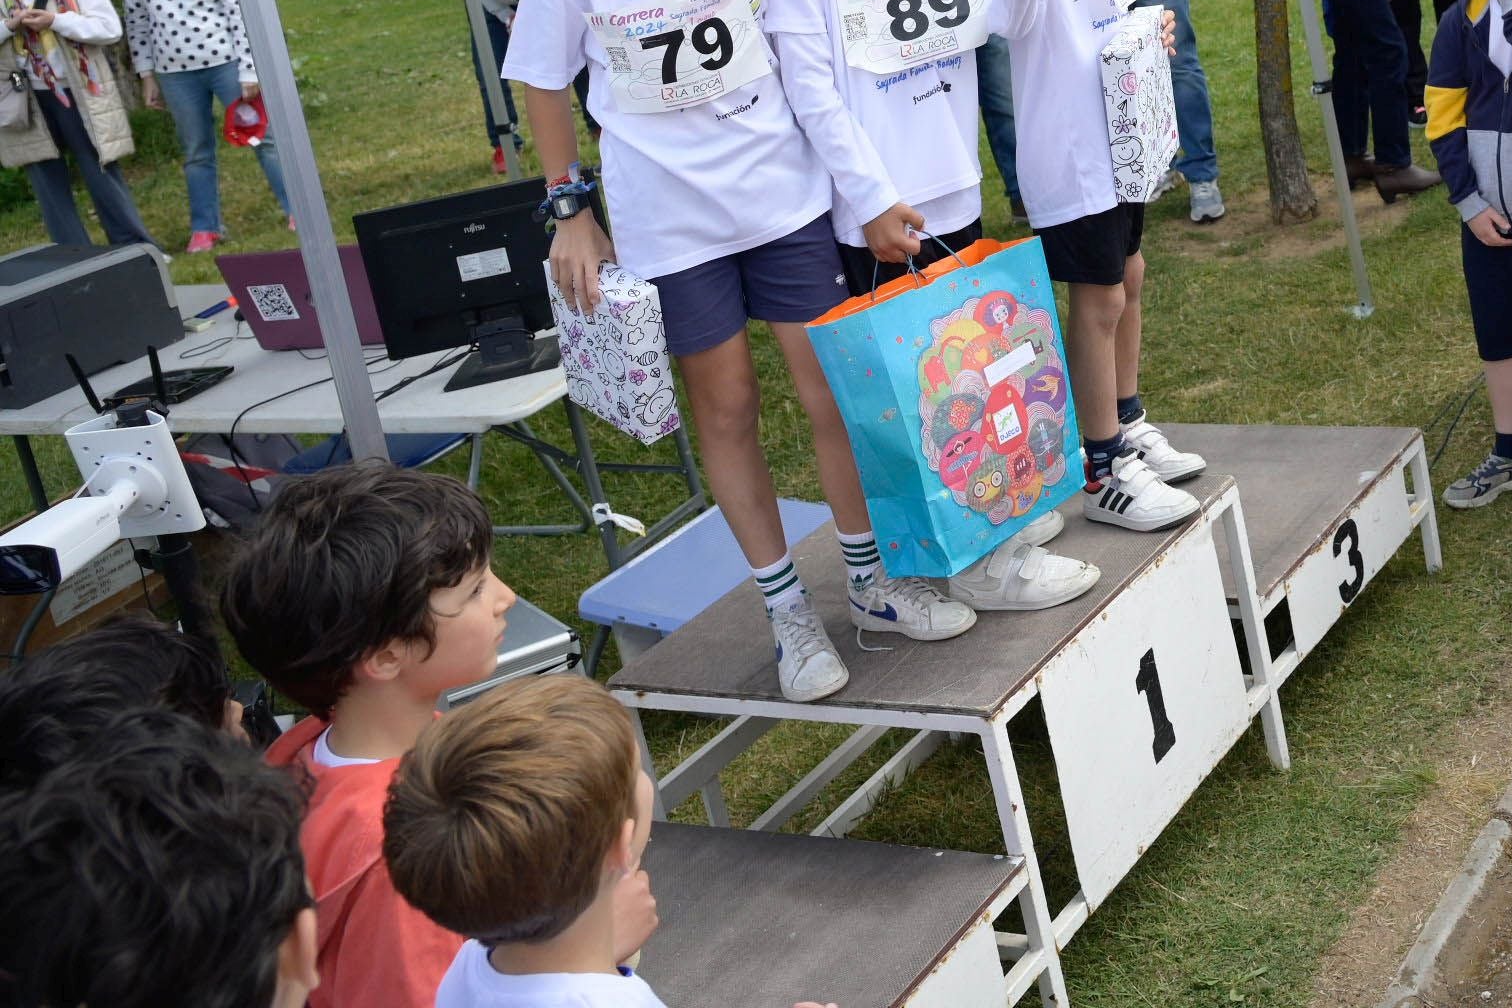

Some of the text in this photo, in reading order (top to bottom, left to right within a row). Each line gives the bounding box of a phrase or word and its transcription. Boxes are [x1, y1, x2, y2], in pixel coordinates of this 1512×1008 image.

[609, 7, 665, 27] Carrera
[624, 21, 668, 38] 2024
[639, 18, 733, 84] 79
[693, 78, 720, 95] ROCA
[463, 222, 486, 233] FUJITSU
[1333, 519, 1364, 603] 3
[1135, 647, 1175, 764] 1
